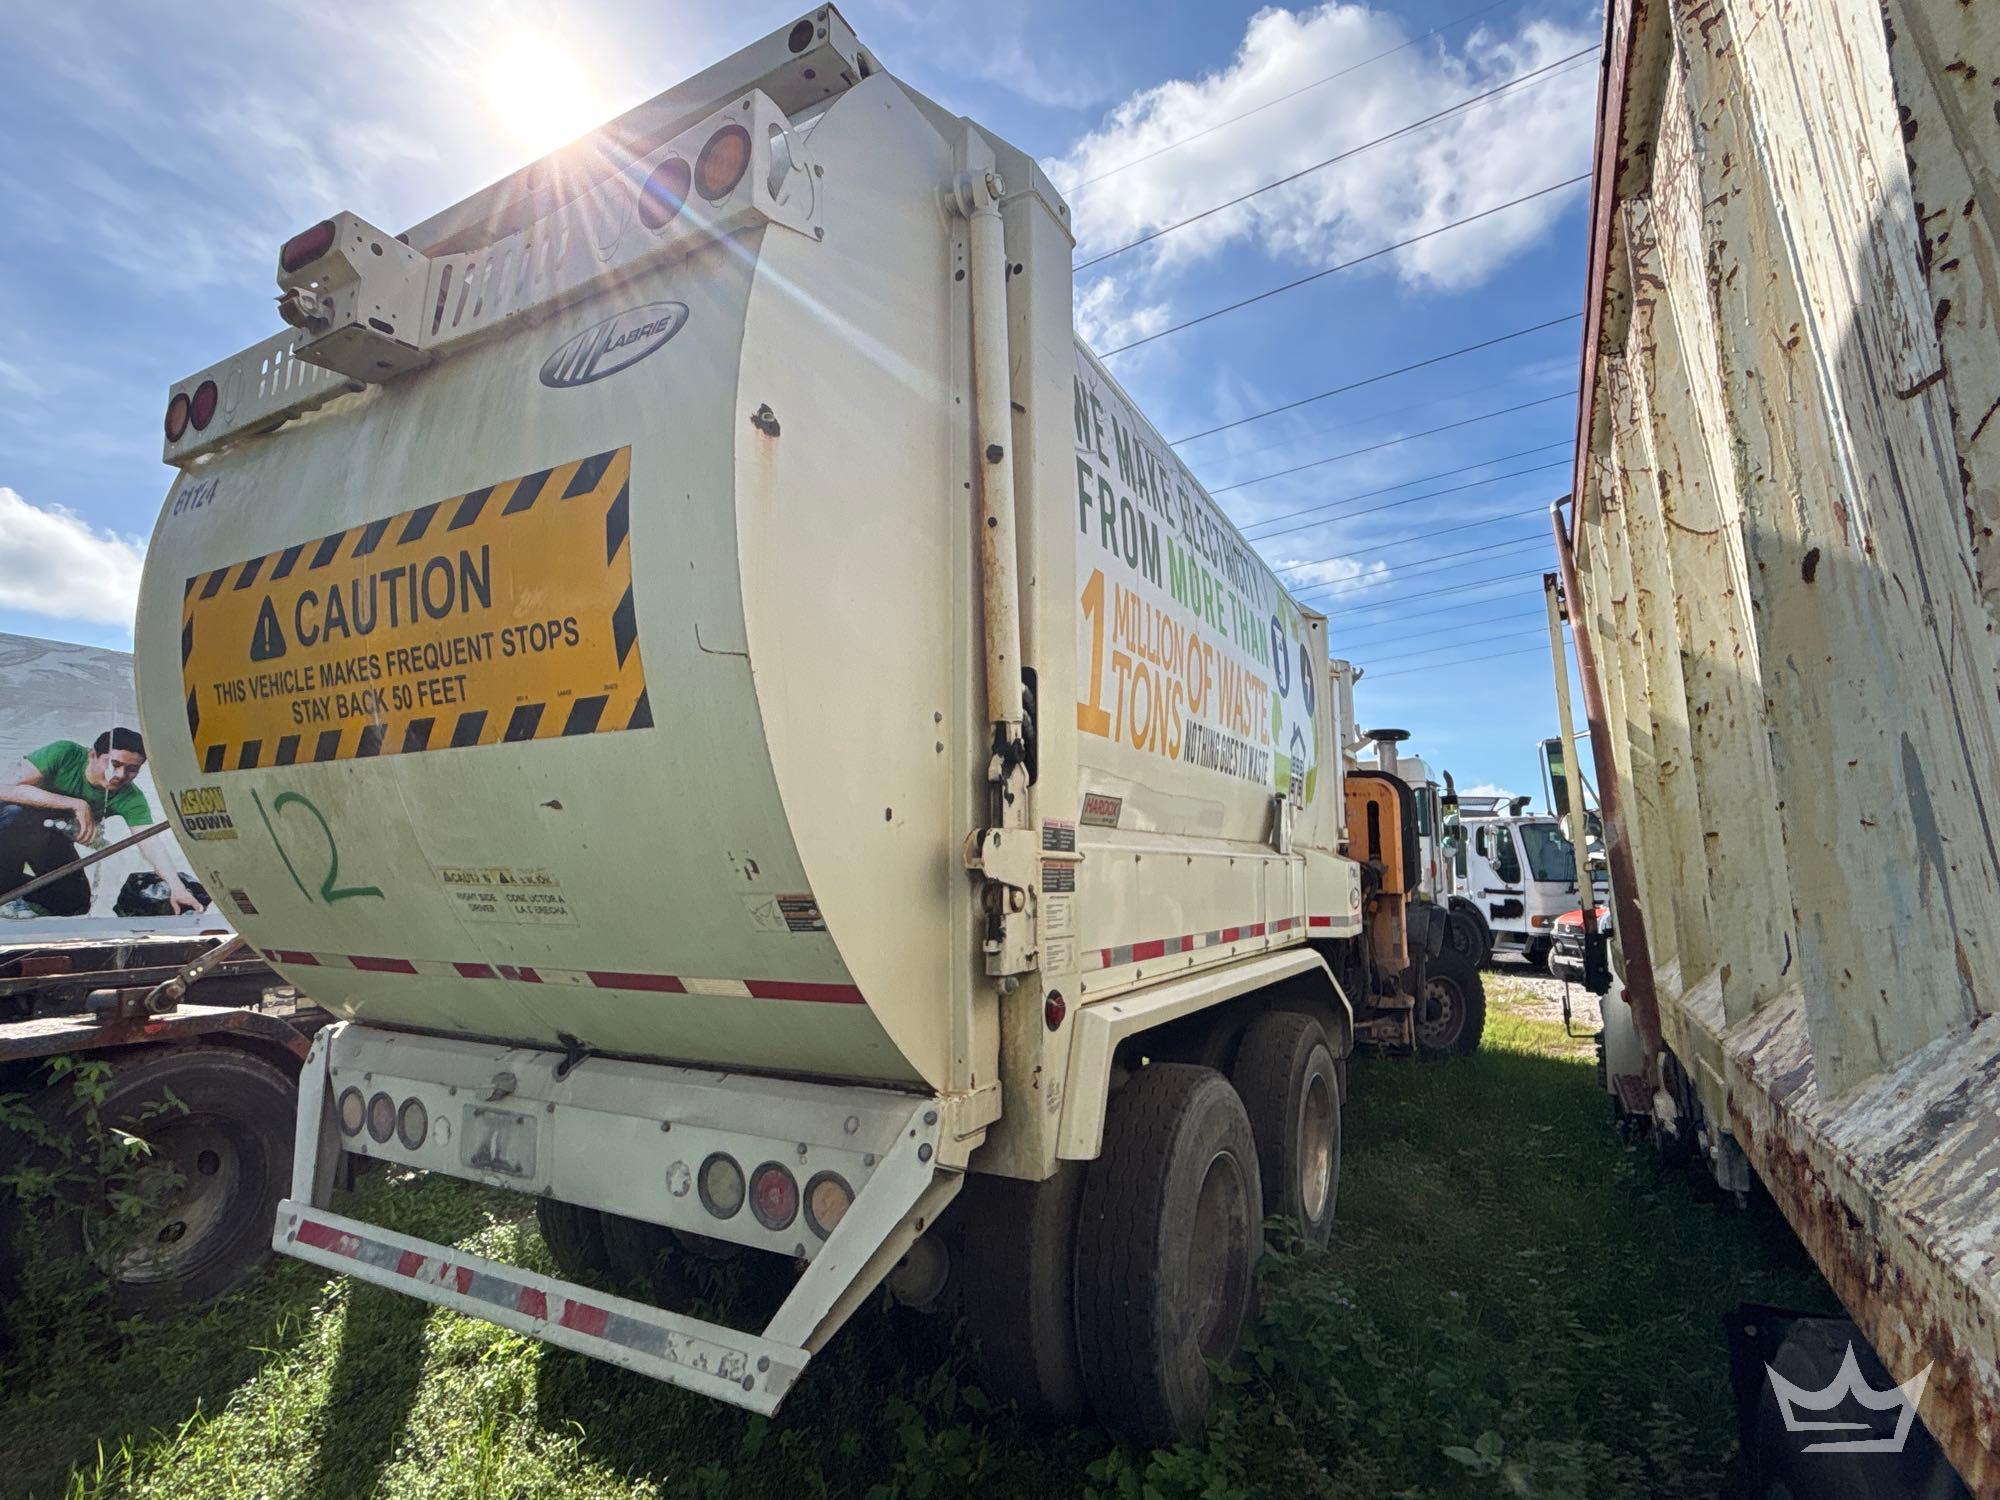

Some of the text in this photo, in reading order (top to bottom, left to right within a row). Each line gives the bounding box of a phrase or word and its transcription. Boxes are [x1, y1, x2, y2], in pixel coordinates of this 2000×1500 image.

[602, 314, 673, 353] LABRIE
[1076, 455, 1269, 669] FROM MORE THAN
[1111, 413, 1175, 528] MAKE
[1175, 484, 1263, 612] ELECTRICITY
[294, 544, 492, 647] CAUTION
[213, 615, 581, 706] THIS VEHICLE MAKES FREQUENT STOPS
[291, 674, 468, 724] STAY BACK 50 FEET
[1077, 567, 1270, 746] 1 MILLION OF WASTE.
[1112, 649, 1184, 761] TONS
[1183, 718, 1269, 786] NOTHING GOES TO WASTE
[185, 814, 234, 831] DOWN
[250, 786, 385, 906] 12
